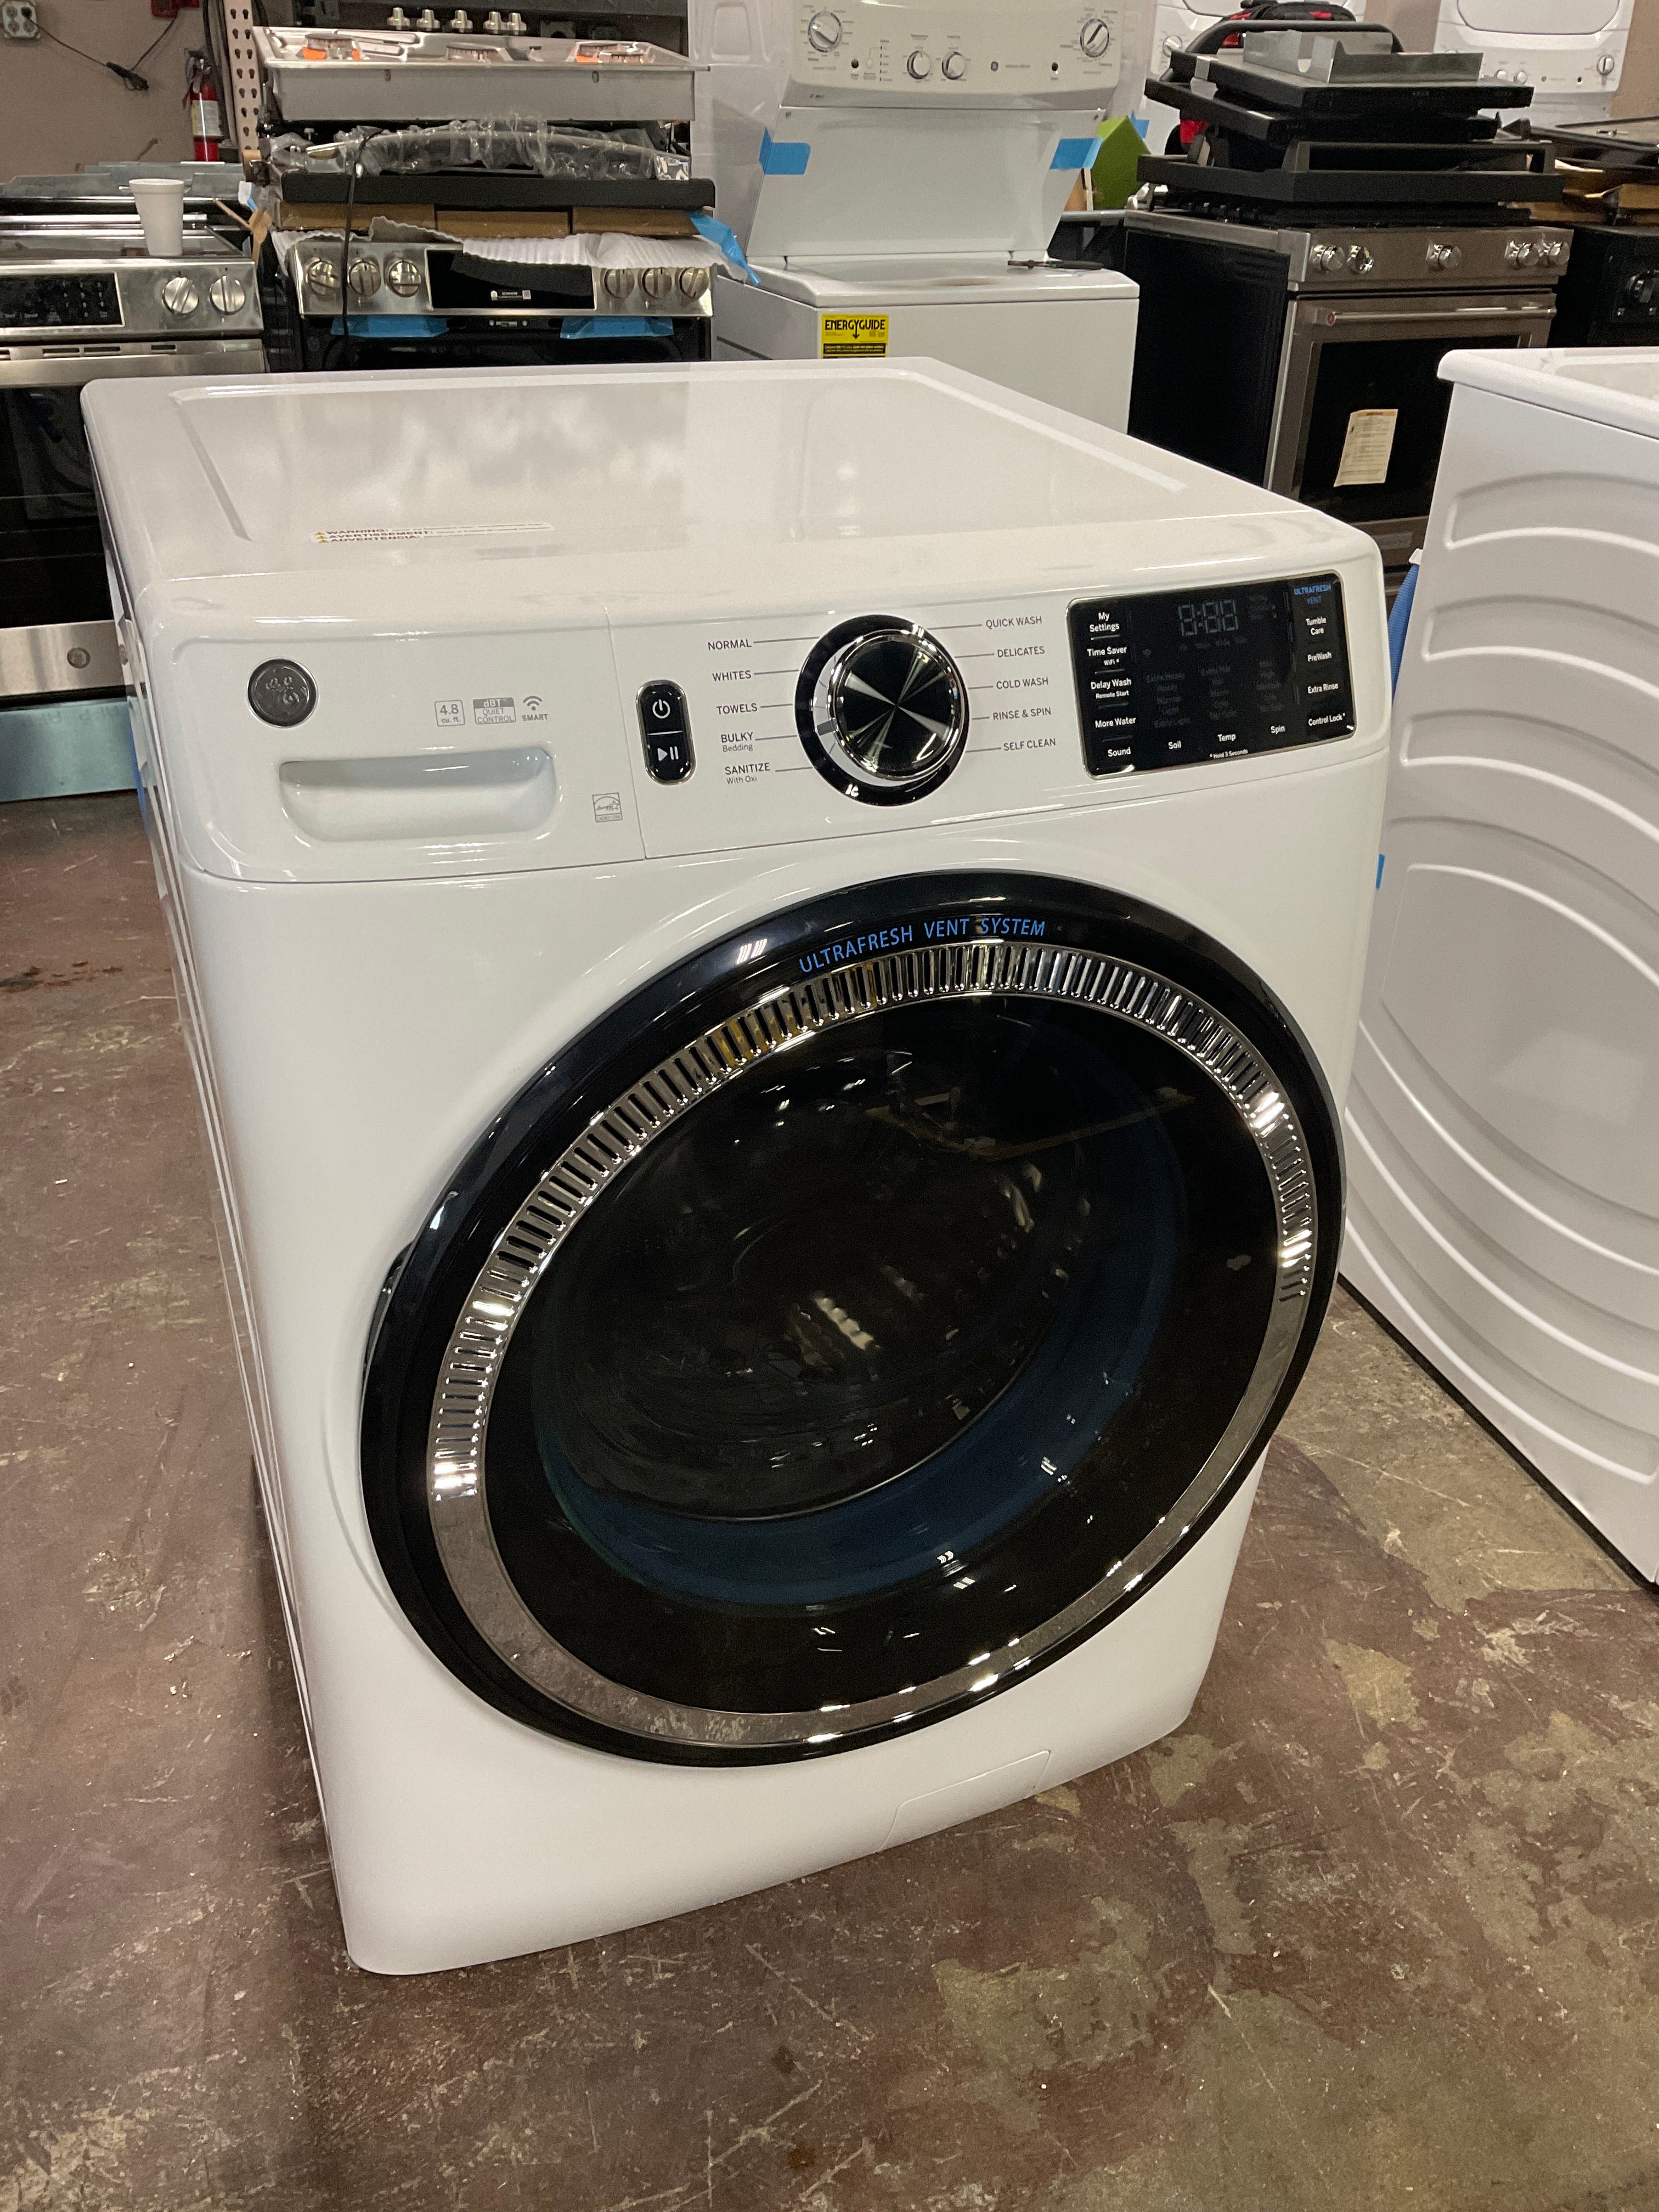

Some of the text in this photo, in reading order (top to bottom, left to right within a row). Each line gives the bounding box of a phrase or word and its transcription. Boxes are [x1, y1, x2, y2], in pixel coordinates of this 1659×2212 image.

[825, 319, 885, 331] ENERGYGUIDE
[1294, 584, 1331, 595] ULTRAFRESH
[1098, 611, 1110, 621] My
[1305, 616, 1327, 626] Tumble
[986, 615, 1042, 630] QUICK WASH
[1089, 623, 1120, 633] Settings
[1310, 627, 1324, 635] Care
[708, 639, 752, 651] NORMAL
[997, 646, 1045, 658] DELICATES
[1086, 646, 1127, 657] Time Saver
[1307, 651, 1332, 662] PreWash
[712, 670, 752, 681] WHITES
[996, 676, 1048, 690] COLD WASH
[1090, 678, 1132, 690] Delay Wash
[1307, 683, 1339, 694] Extra Rinse
[483, 699, 501, 707] dBT
[439, 703, 459, 715] 4.8
[716, 703, 758, 715] TOWELS
[992, 707, 1052, 721] RINSE & SPIN
[1094, 716, 1137, 729] More Water
[1308, 715, 1329, 726] Control
[1270, 725, 1286, 735] Spin
[721, 732, 753, 743] BULKY
[1217, 733, 1236, 742] Temp
[722, 743, 753, 752] Bedding
[1003, 737, 1056, 751] SELF CLEAN
[1168, 740, 1182, 750] Soil
[1107, 747, 1131, 757] Sound
[725, 762, 771, 775] SANITIZE
[726, 776, 743, 785] With
[799, 917, 1045, 973] ULTRAFRESH VENT SYSTEM
